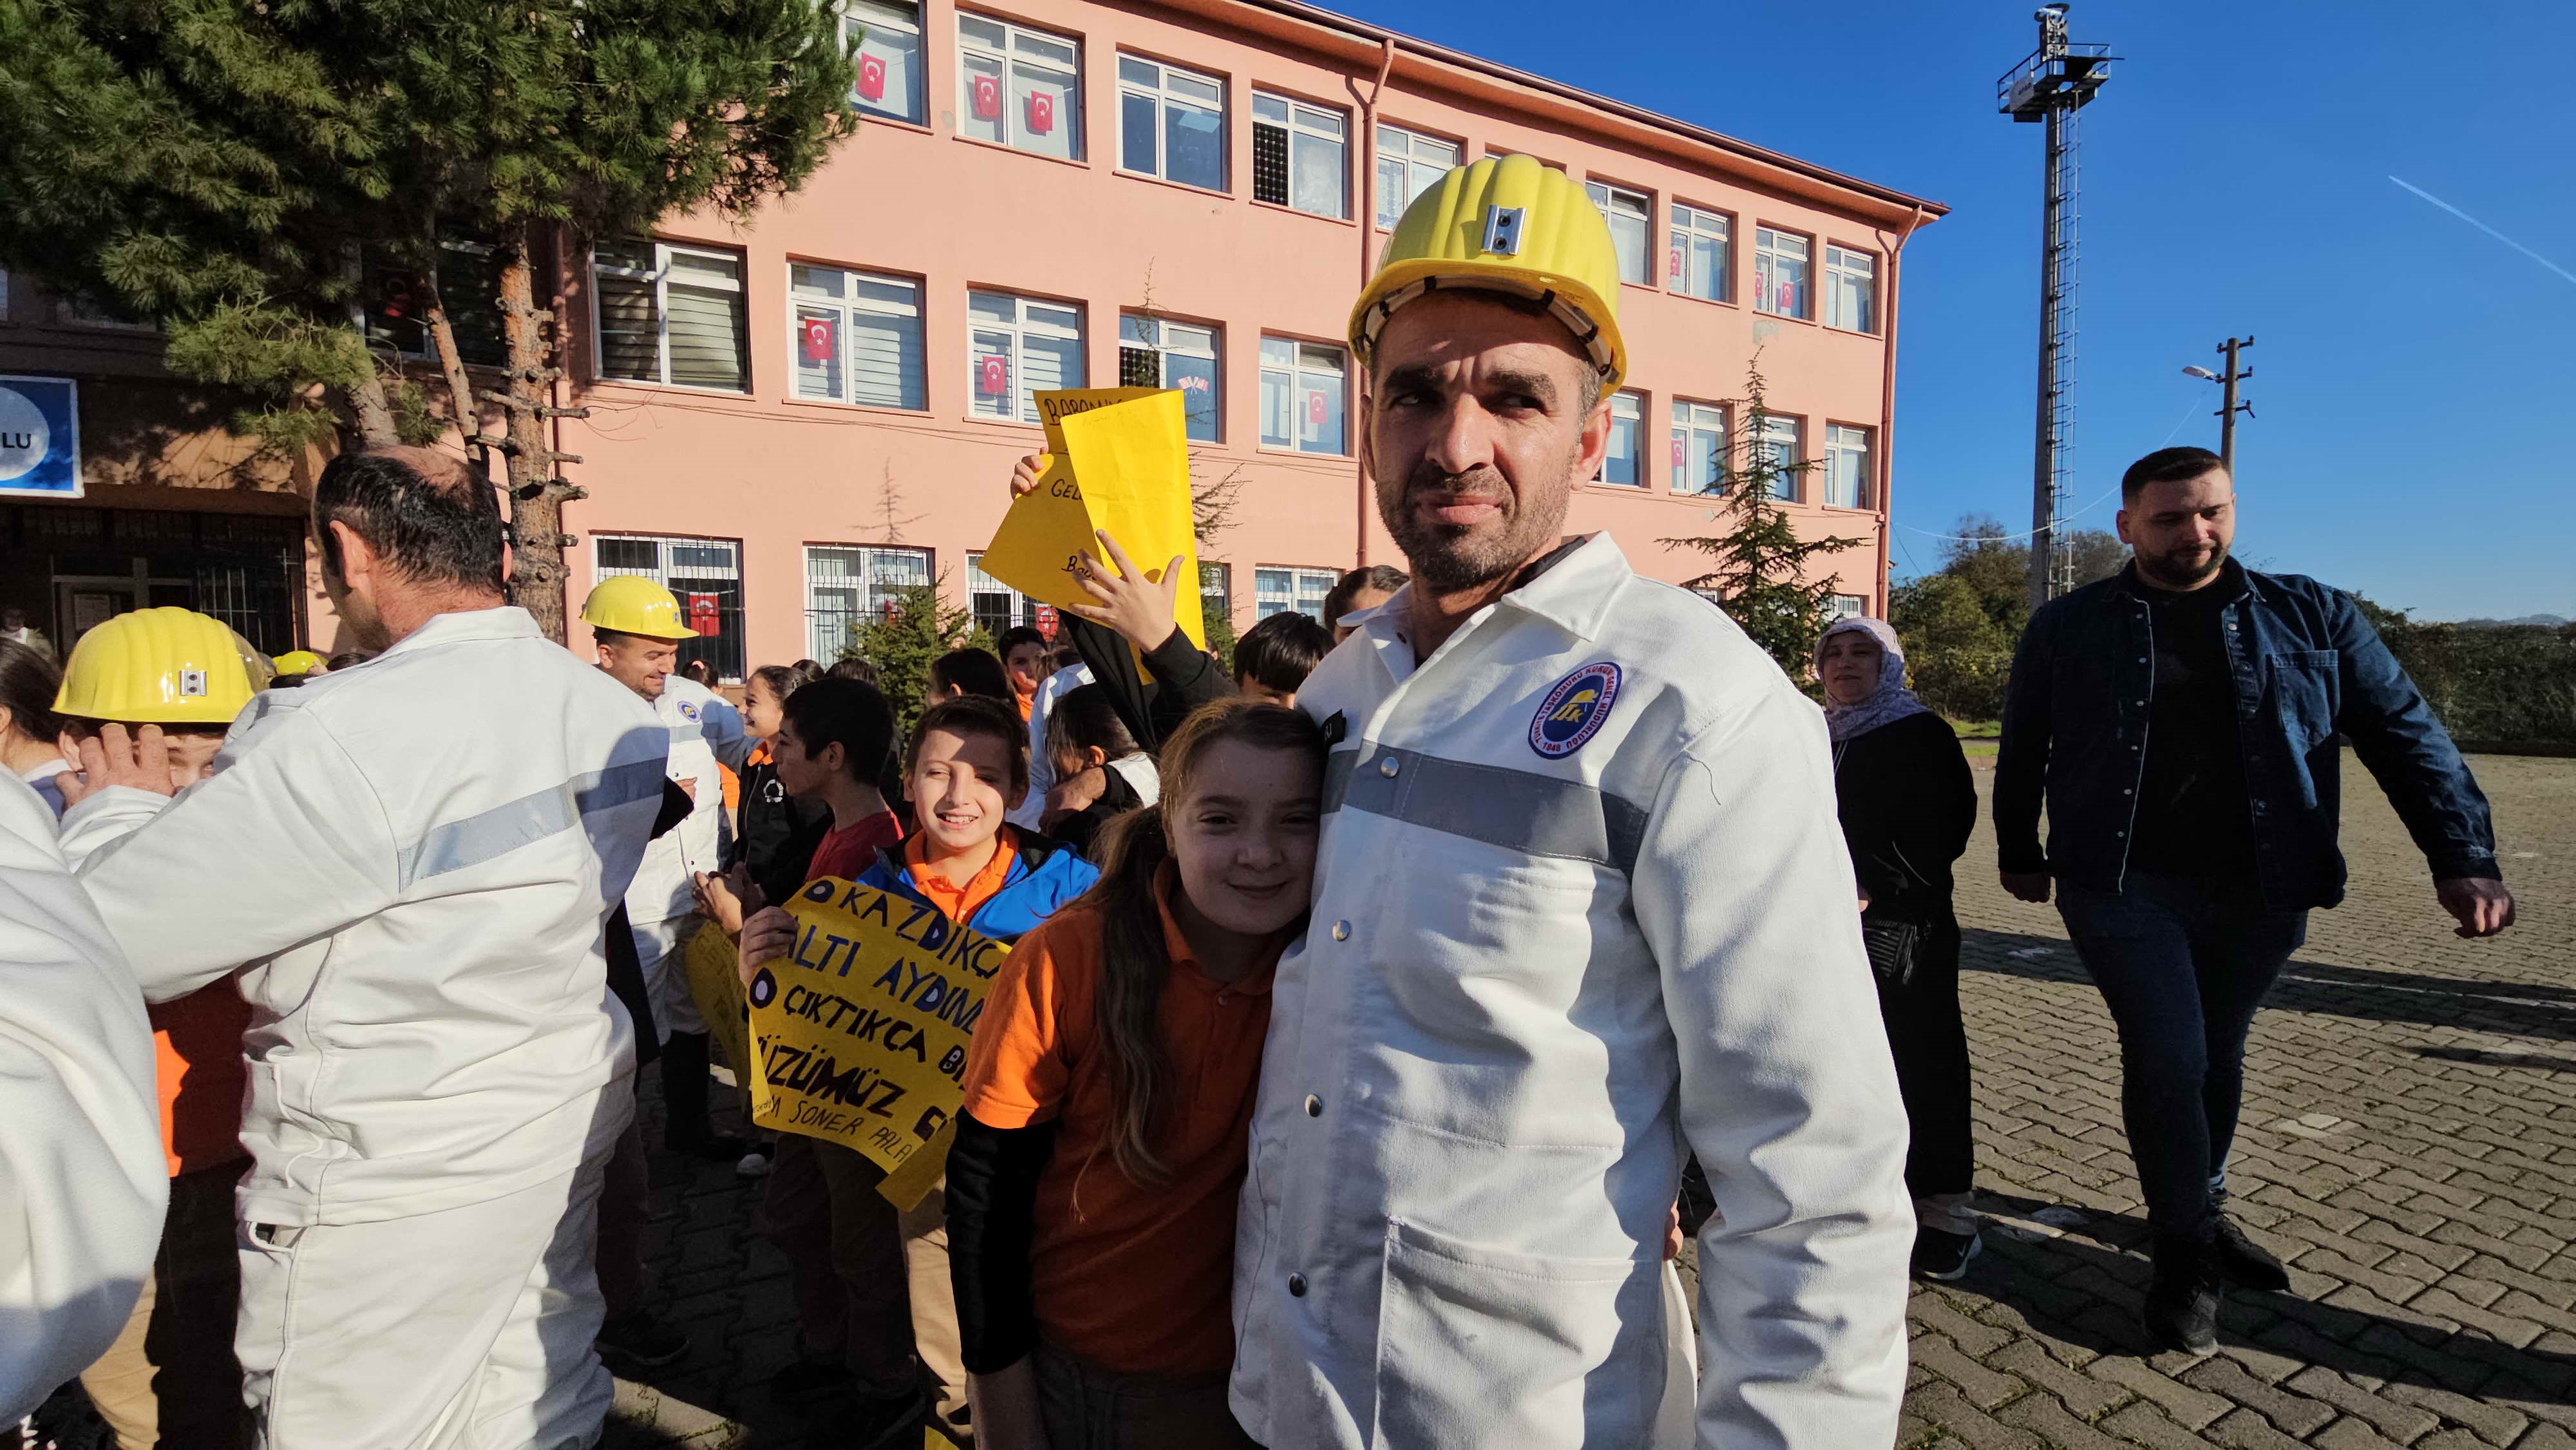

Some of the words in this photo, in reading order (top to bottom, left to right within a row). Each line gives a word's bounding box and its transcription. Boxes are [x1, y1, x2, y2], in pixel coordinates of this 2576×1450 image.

[1051, 478, 1083, 500] GEL
[757, 1034, 907, 1118] ÜZÜMÜZ
[788, 1100, 864, 1136] SONER
